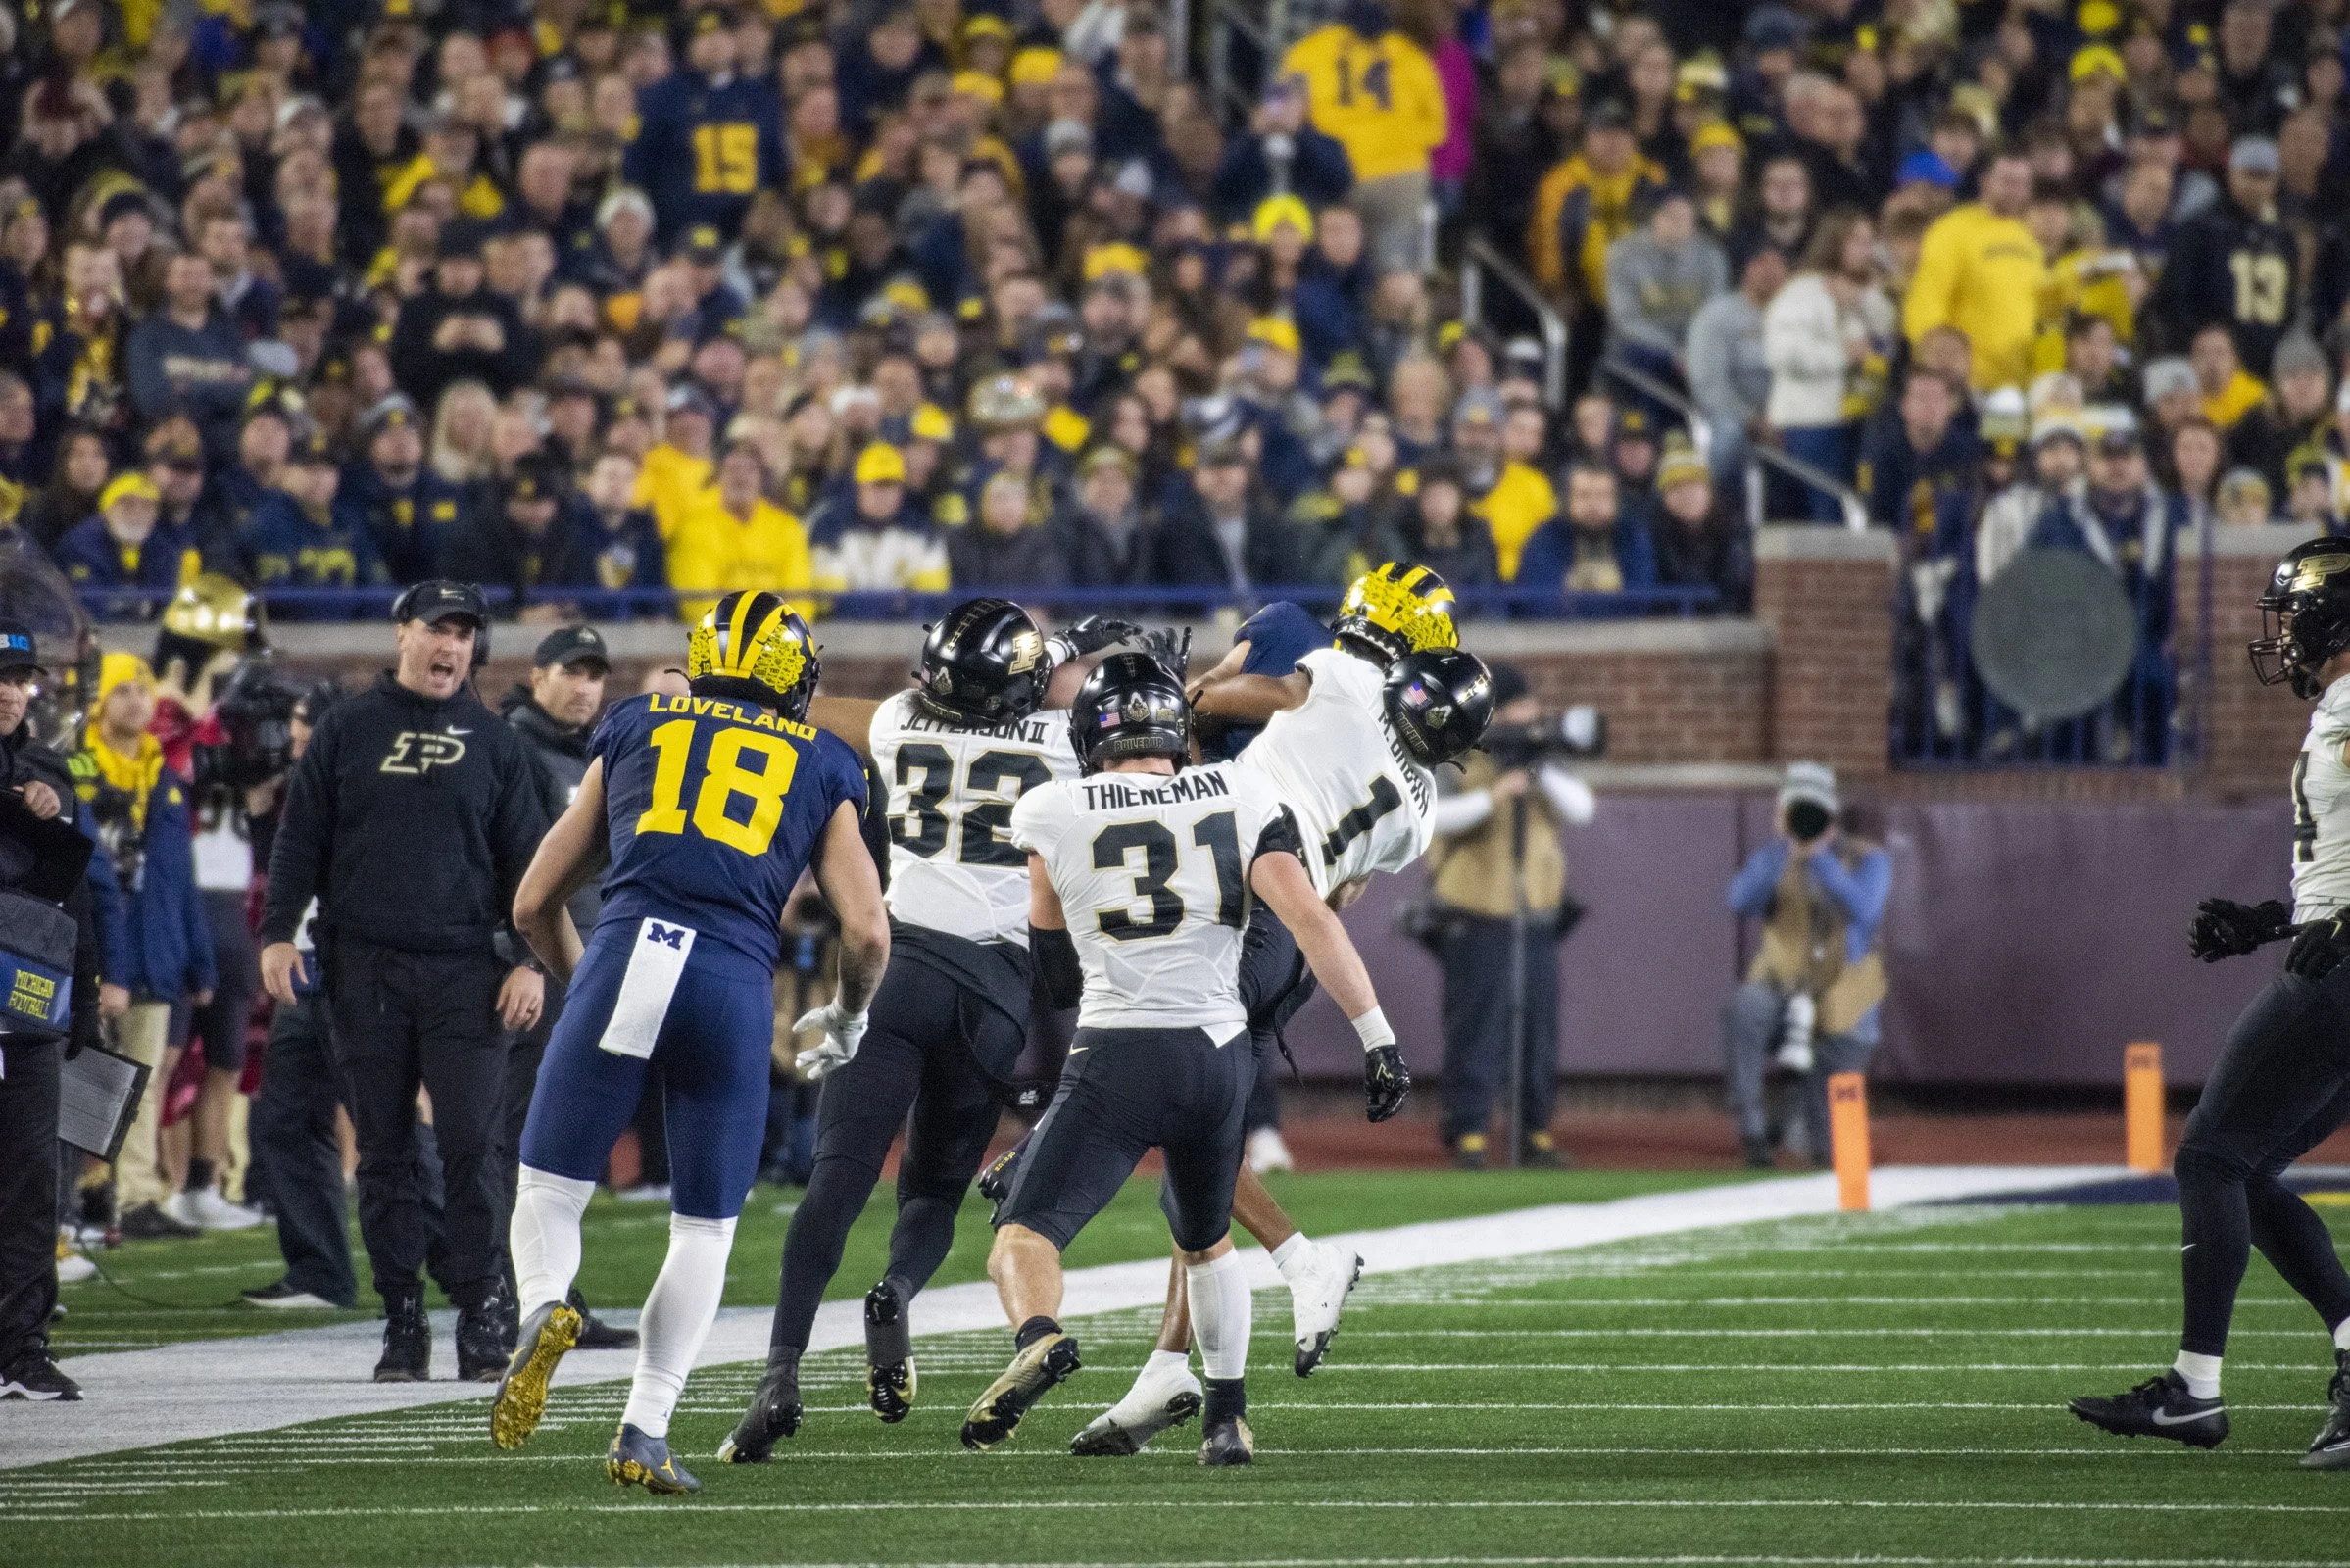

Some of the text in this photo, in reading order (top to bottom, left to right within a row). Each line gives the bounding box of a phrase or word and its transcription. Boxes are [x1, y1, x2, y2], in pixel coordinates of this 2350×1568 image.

[1336, 56, 1390, 110] 14
[693, 122, 758, 192] 15
[2289, 553, 2350, 592] P
[1008, 630, 1045, 675] P
[649, 694, 818, 741] LOVELAND
[636, 719, 799, 857] 18
[887, 741, 1055, 867] 32
[1082, 770, 1229, 810] THIENEMAN
[1320, 771, 1403, 869] 1
[1090, 808, 1246, 944] 31
[647, 922, 686, 951] M
[8, 990, 49, 1019] FOOTBALL
[15, 969, 55, 999] MICHIGAN
